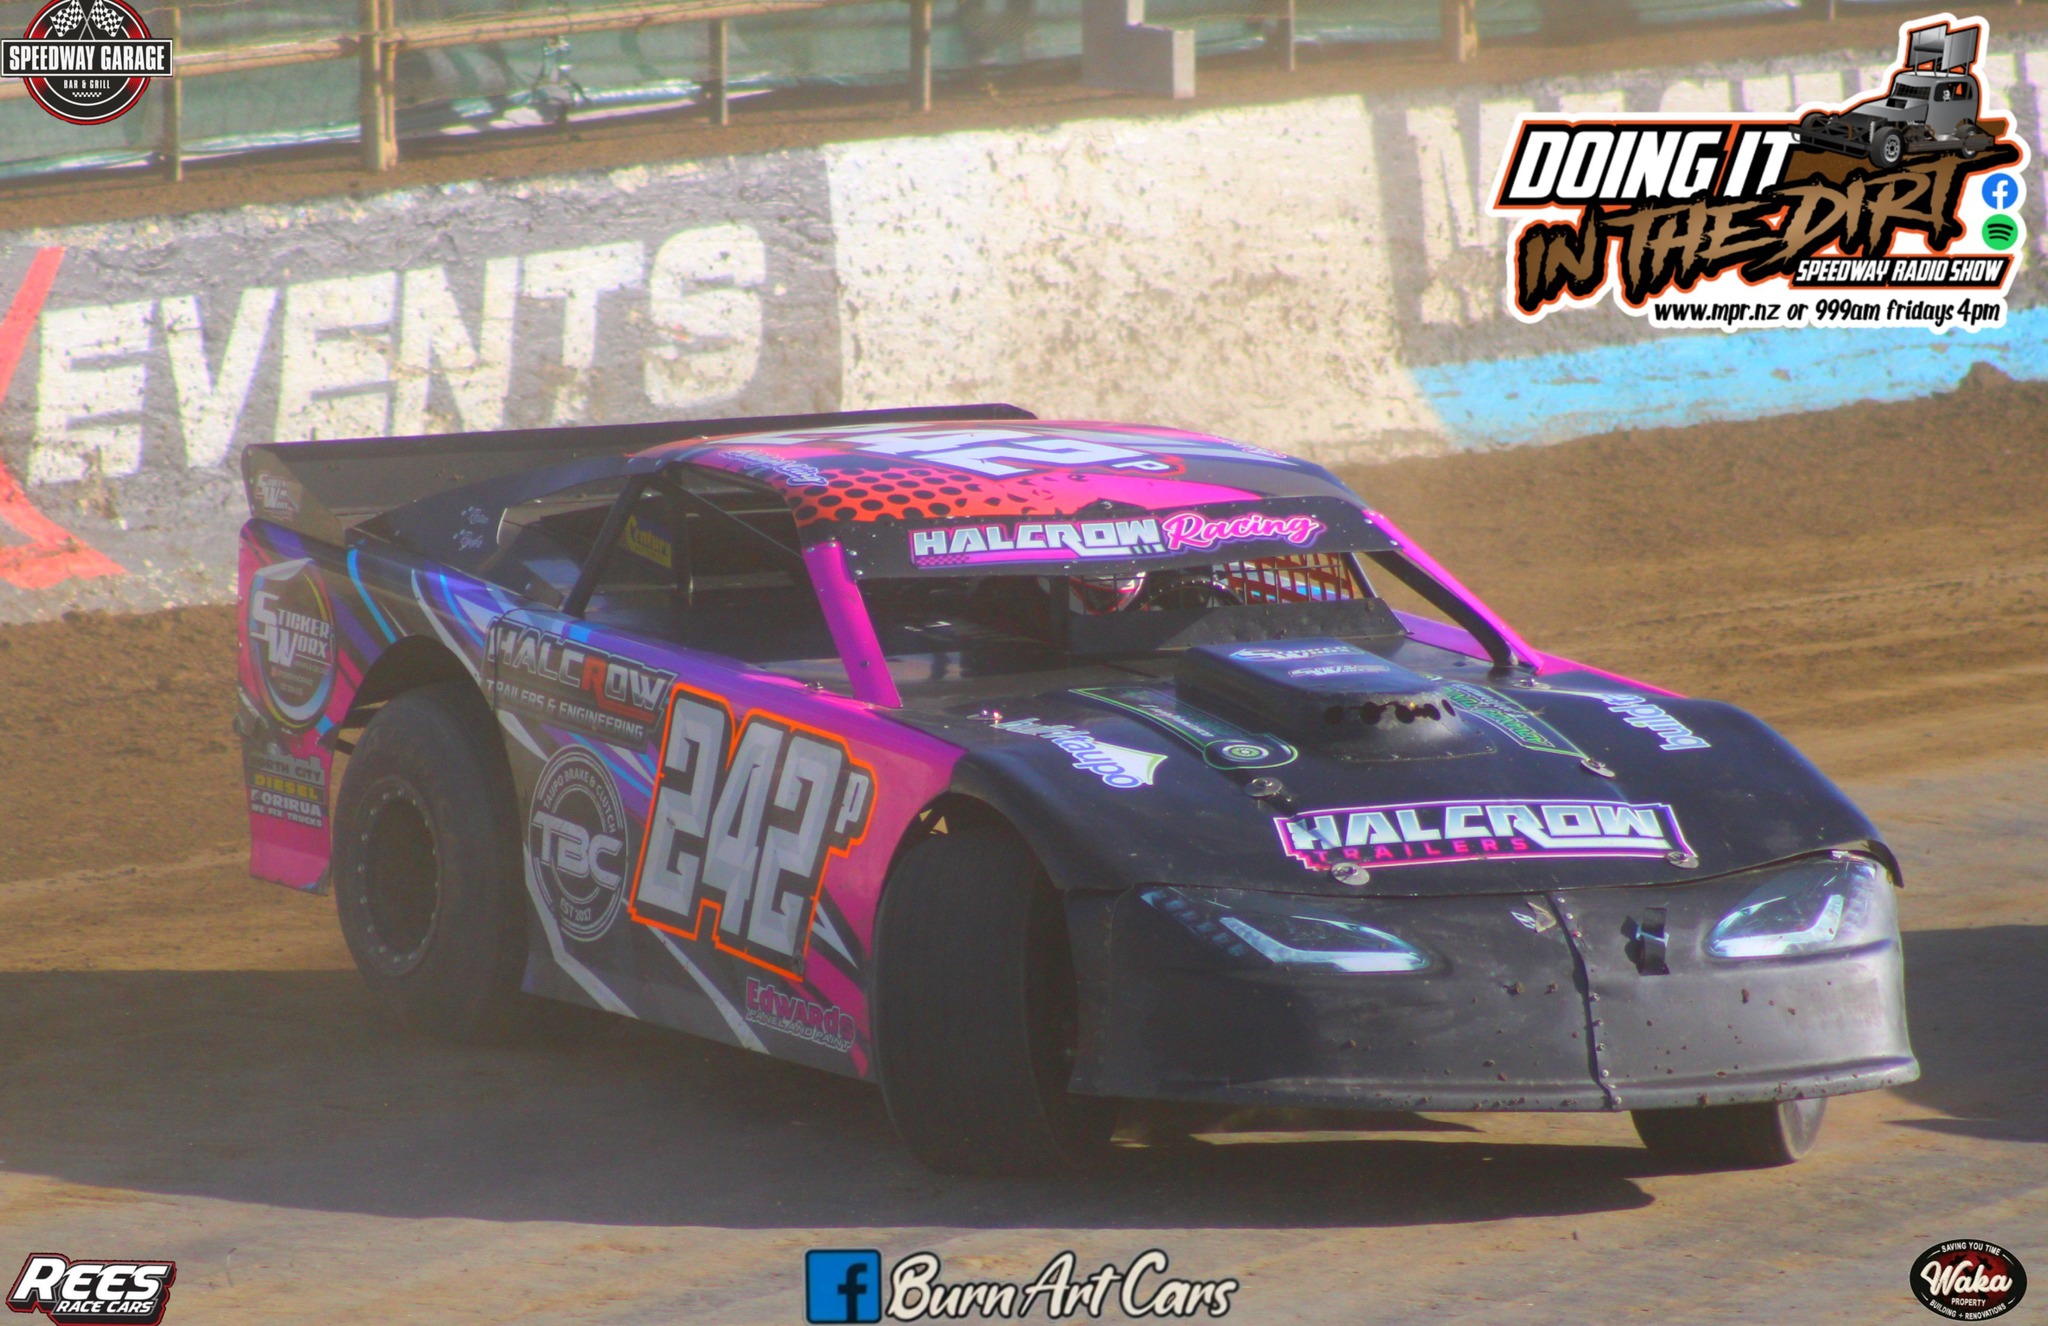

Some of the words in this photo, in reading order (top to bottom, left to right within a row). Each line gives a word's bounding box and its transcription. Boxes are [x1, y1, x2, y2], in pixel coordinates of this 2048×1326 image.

[27, 224, 766, 485] EVENTS
[914, 519, 1165, 557] HALCROW
[1165, 513, 1318, 551] Racing
[250, 590, 330, 641] STICKER
[268, 627, 328, 667] WORX
[487, 627, 667, 722] HALCROW
[559, 702, 644, 738] ENGINEERING
[254, 773, 318, 800] DIESEL
[543, 775, 564, 810] TAUPO
[564, 768, 589, 783] BRAKE
[596, 785, 616, 833] CLUTCH
[287, 812, 323, 828] TRUCKS
[637, 697, 842, 957] 242
[1287, 805, 1671, 849] HALCROW
[532, 811, 623, 890] TBC
[1318, 837, 1530, 861] TRAILERS
[813, 1031, 850, 1052] PAINT
